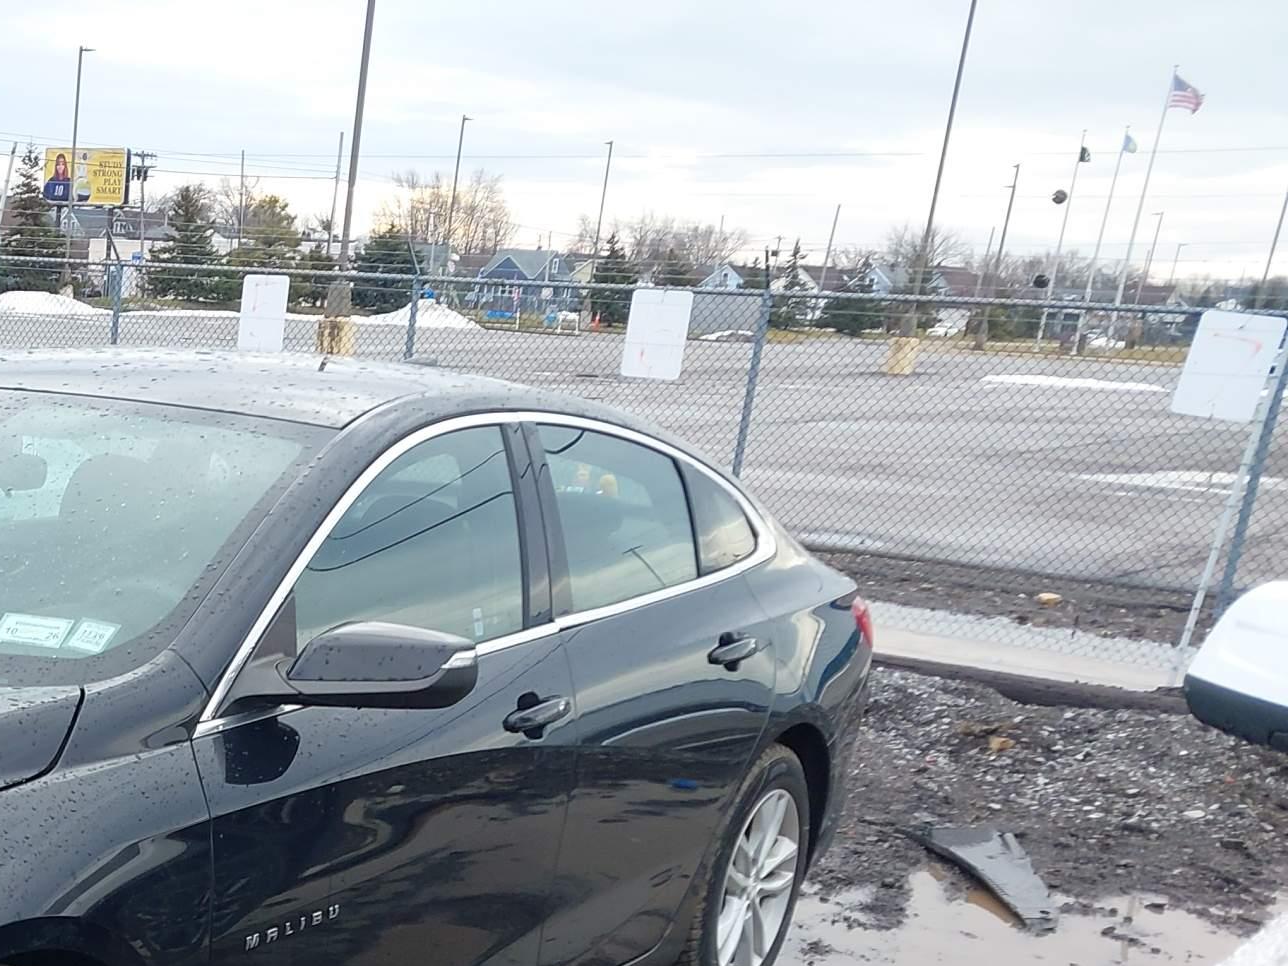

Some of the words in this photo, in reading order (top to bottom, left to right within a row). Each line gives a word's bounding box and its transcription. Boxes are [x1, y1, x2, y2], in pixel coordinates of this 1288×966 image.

[98, 161, 123, 169] STUDY
[92, 169, 123, 178] STRONG
[103, 178, 122, 186] PLAY
[53, 185, 64, 196] 10
[96, 187, 122, 195] SMART
[245, 904, 340, 951] MALIBU
